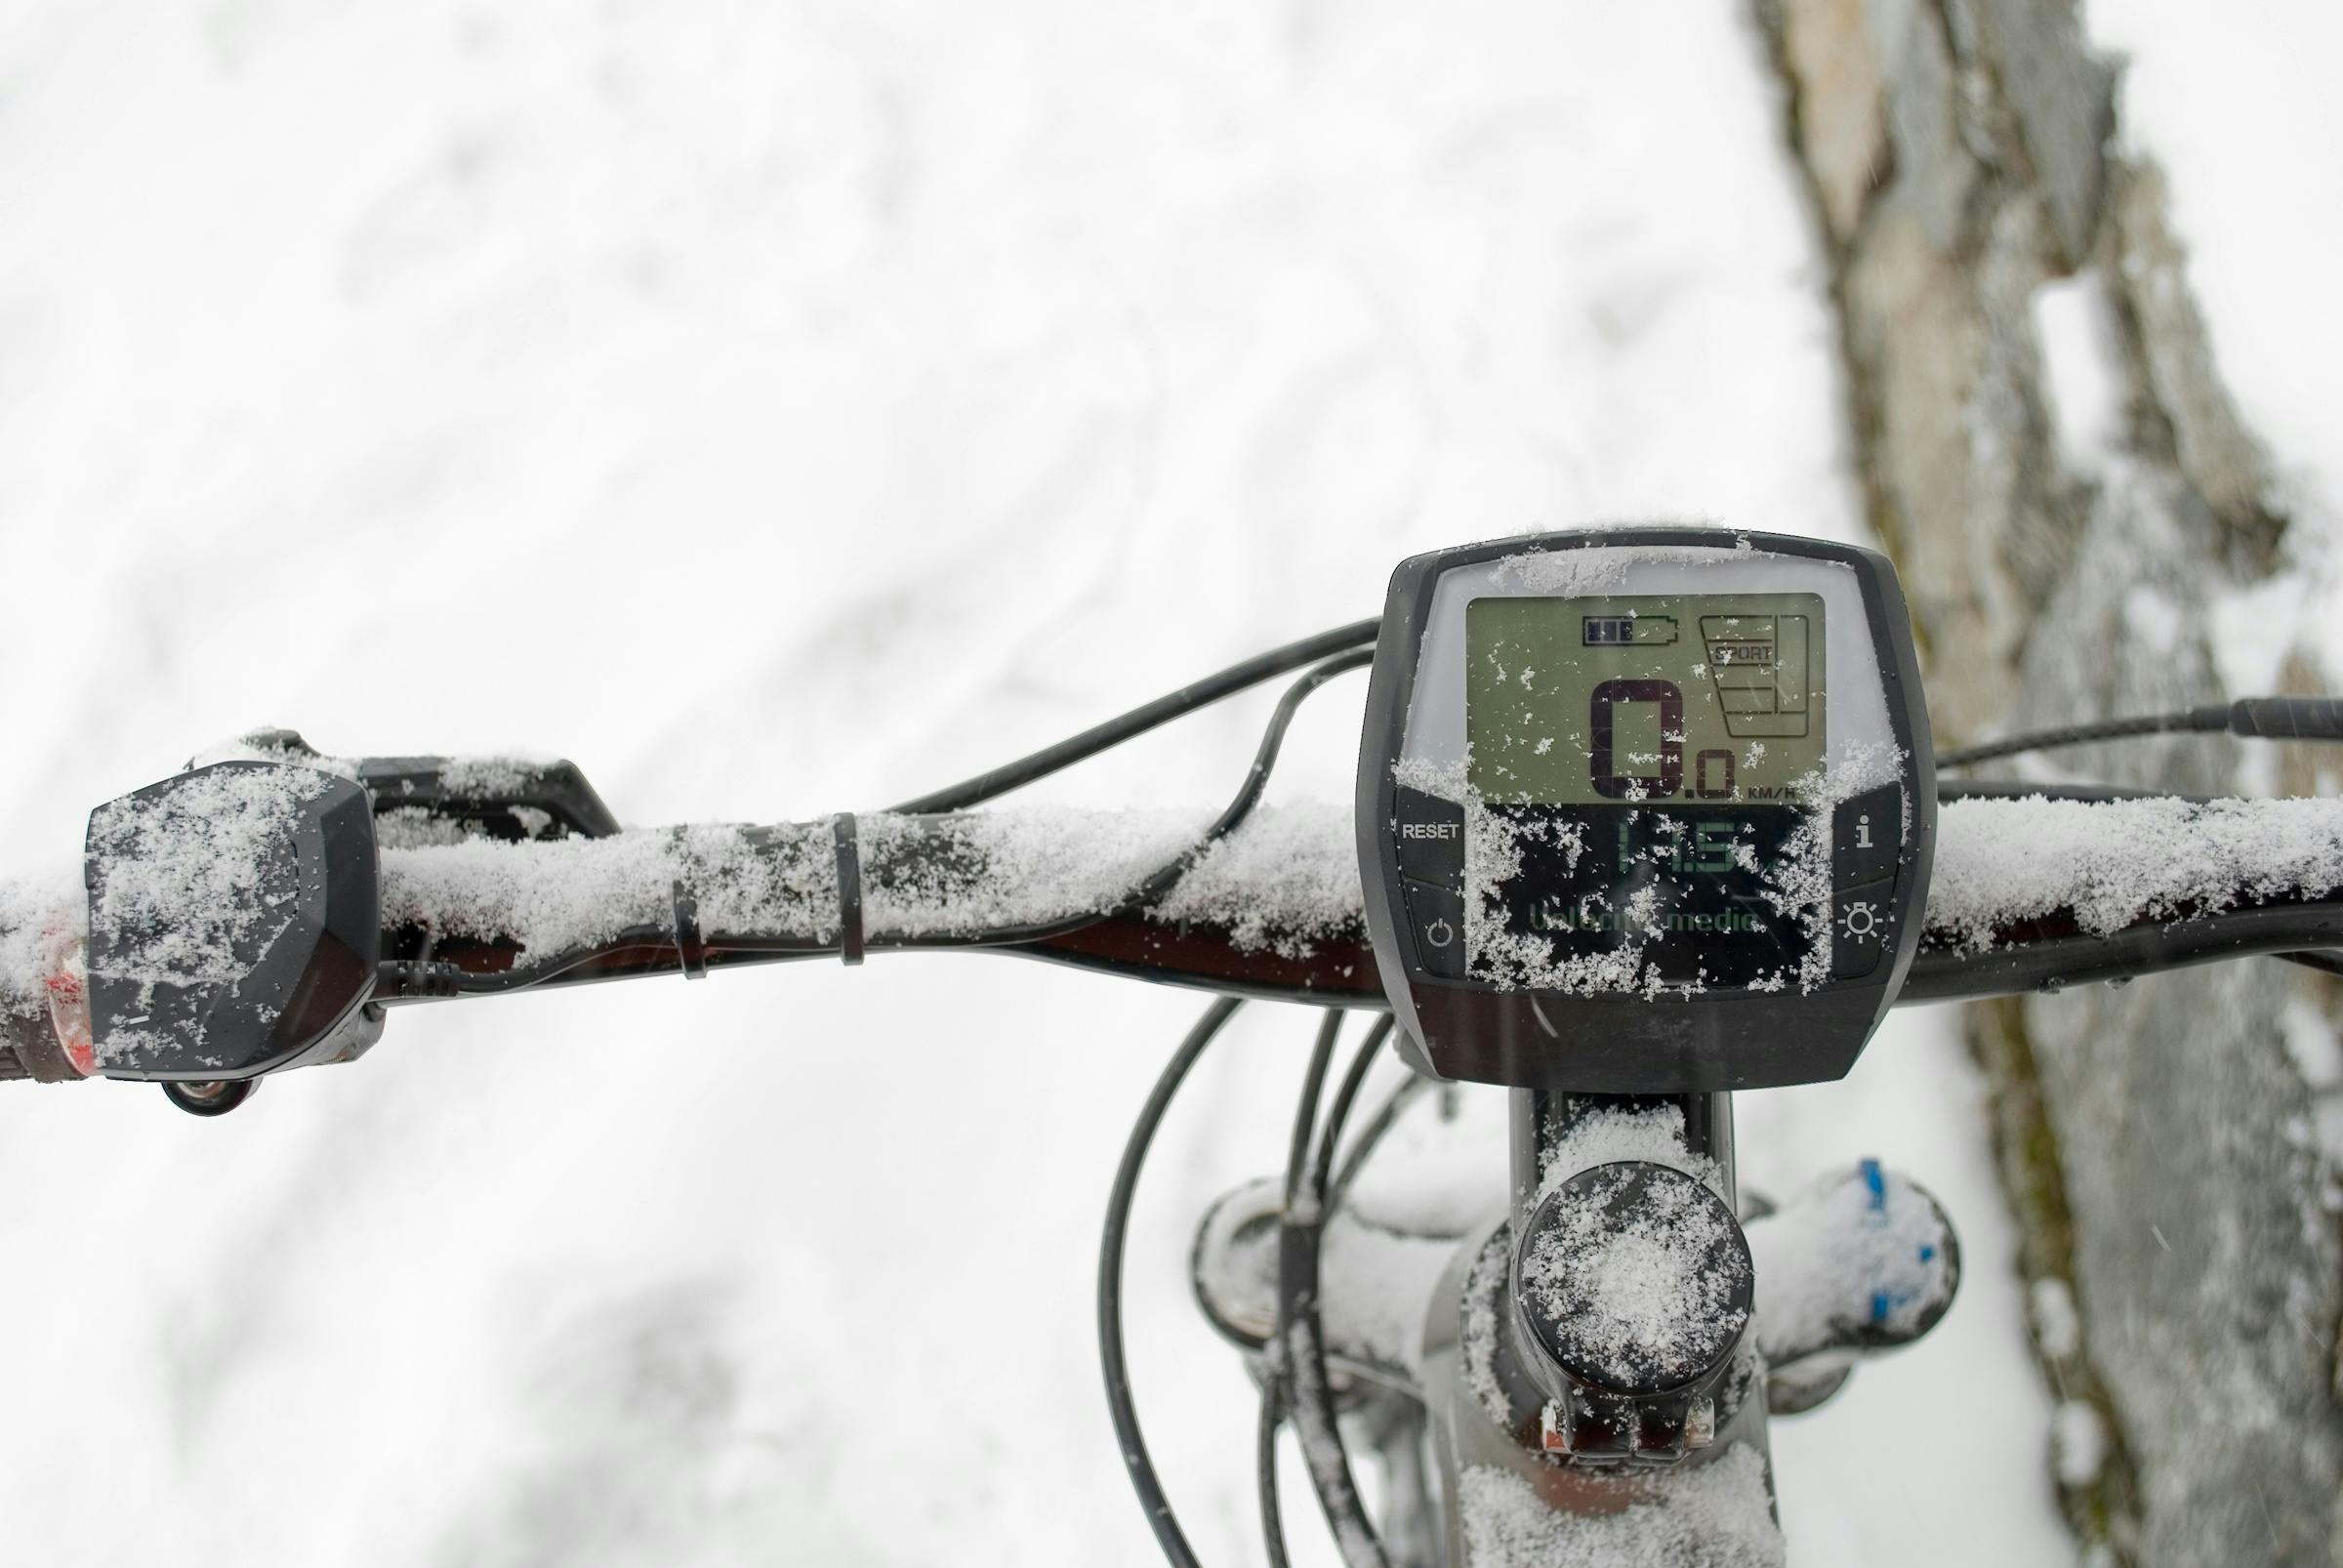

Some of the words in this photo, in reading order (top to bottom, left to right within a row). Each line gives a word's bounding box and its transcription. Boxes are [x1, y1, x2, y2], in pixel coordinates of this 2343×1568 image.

[1715, 646, 1772, 660] SPORT
[1590, 680, 1735, 799] 0.0
[1747, 787, 1795, 799] KM/H
[1403, 823, 1459, 840] RESET
